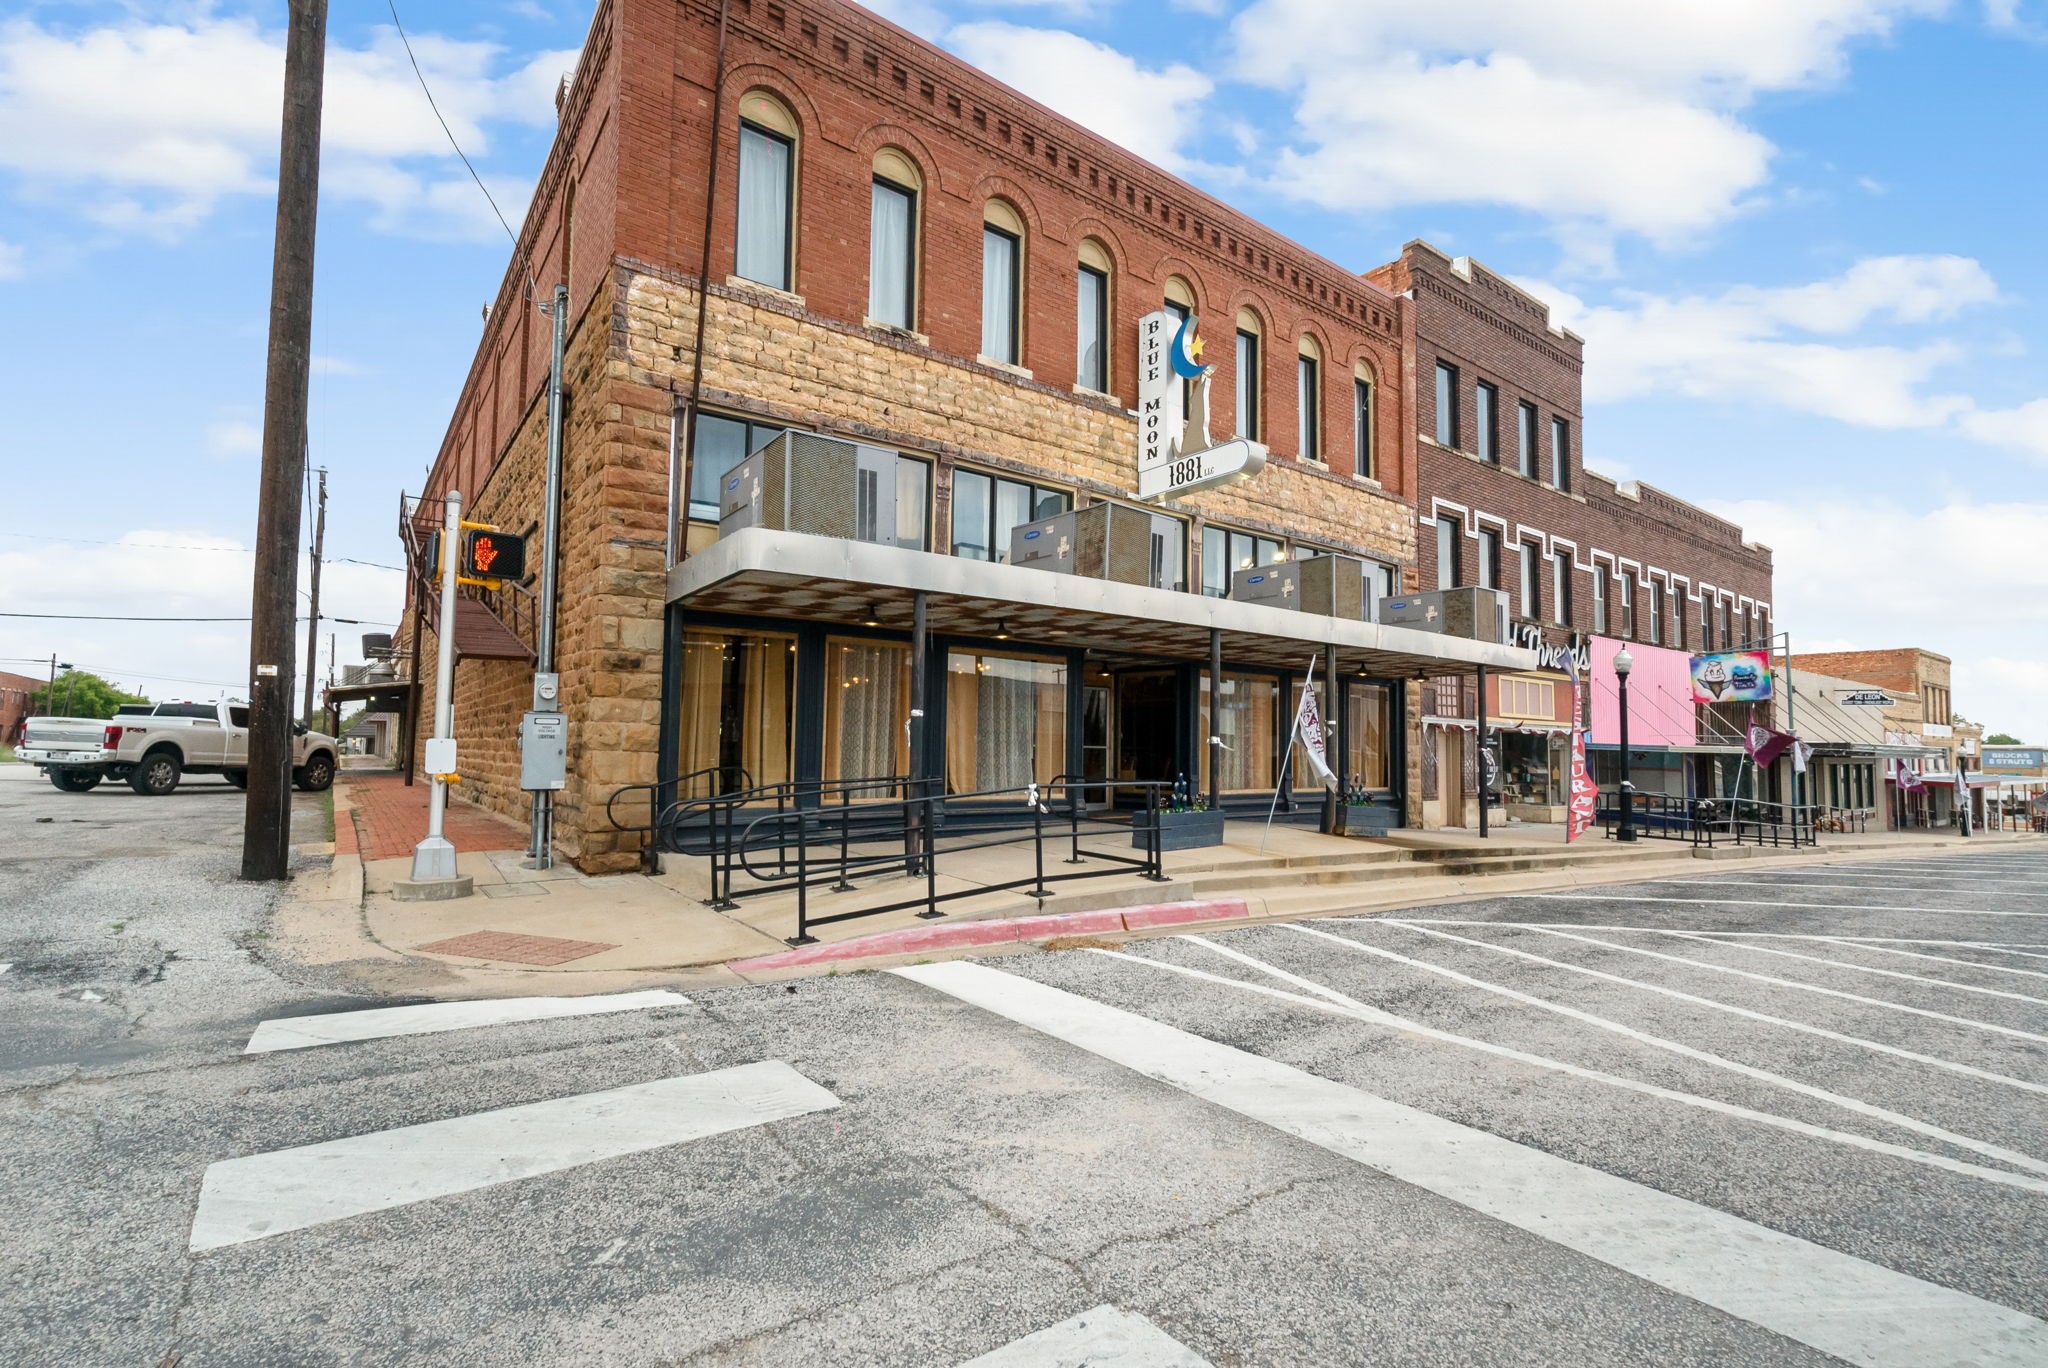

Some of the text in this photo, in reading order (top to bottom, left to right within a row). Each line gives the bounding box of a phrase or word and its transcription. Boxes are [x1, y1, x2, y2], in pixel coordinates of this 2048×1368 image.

[1145, 319, 1162, 461] BLUE MOON
[1168, 456, 1203, 488] 1881
[1522, 624, 1591, 671] Threds
